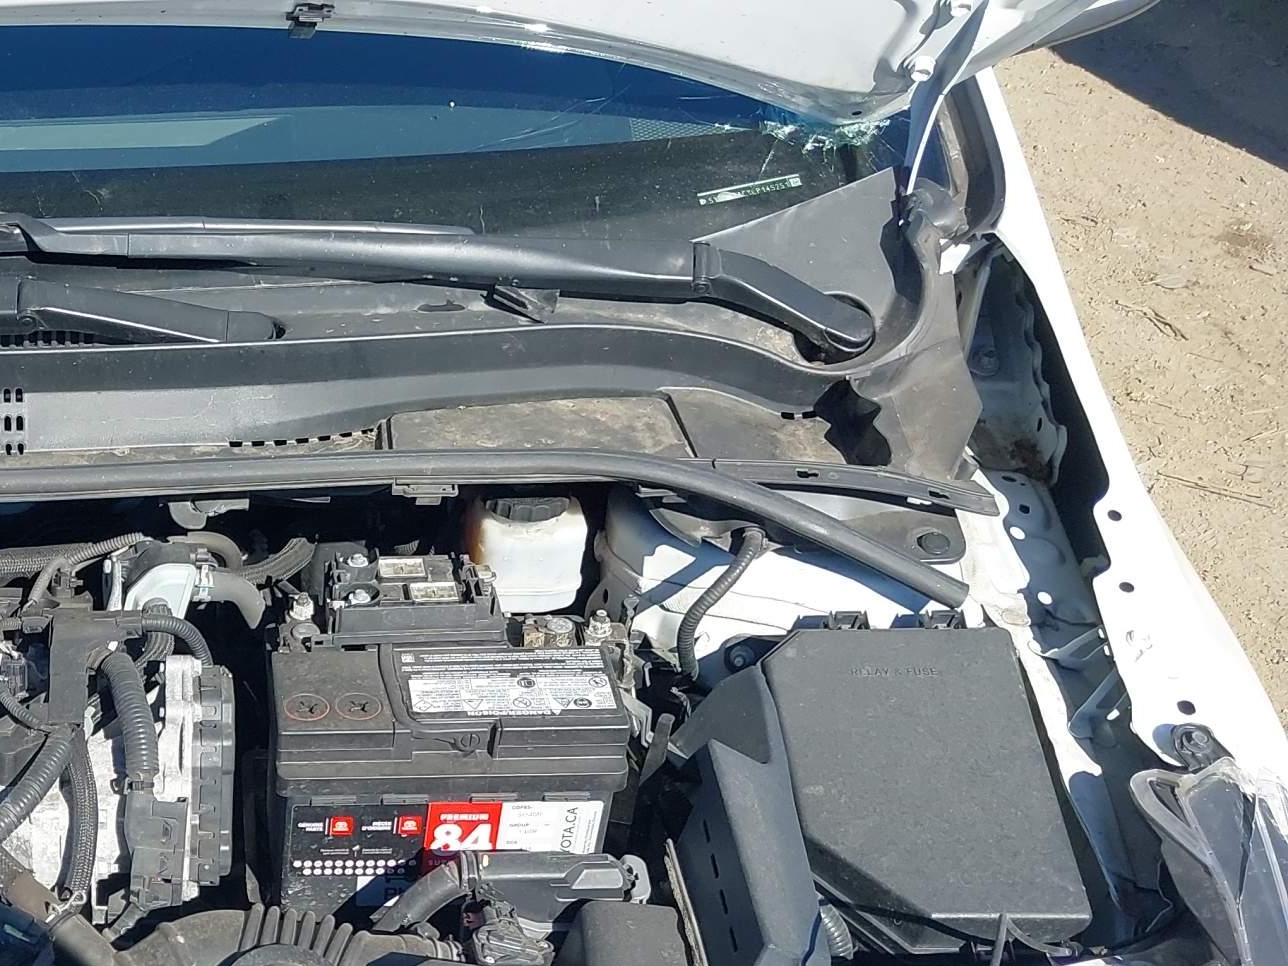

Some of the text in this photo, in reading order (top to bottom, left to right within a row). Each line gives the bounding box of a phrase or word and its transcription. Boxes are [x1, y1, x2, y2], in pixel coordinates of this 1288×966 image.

[849, 666, 889, 677] RELAY
[905, 666, 937, 677] FUSE
[440, 813, 489, 821] PREMIUM
[430, 823, 493, 853] 84
